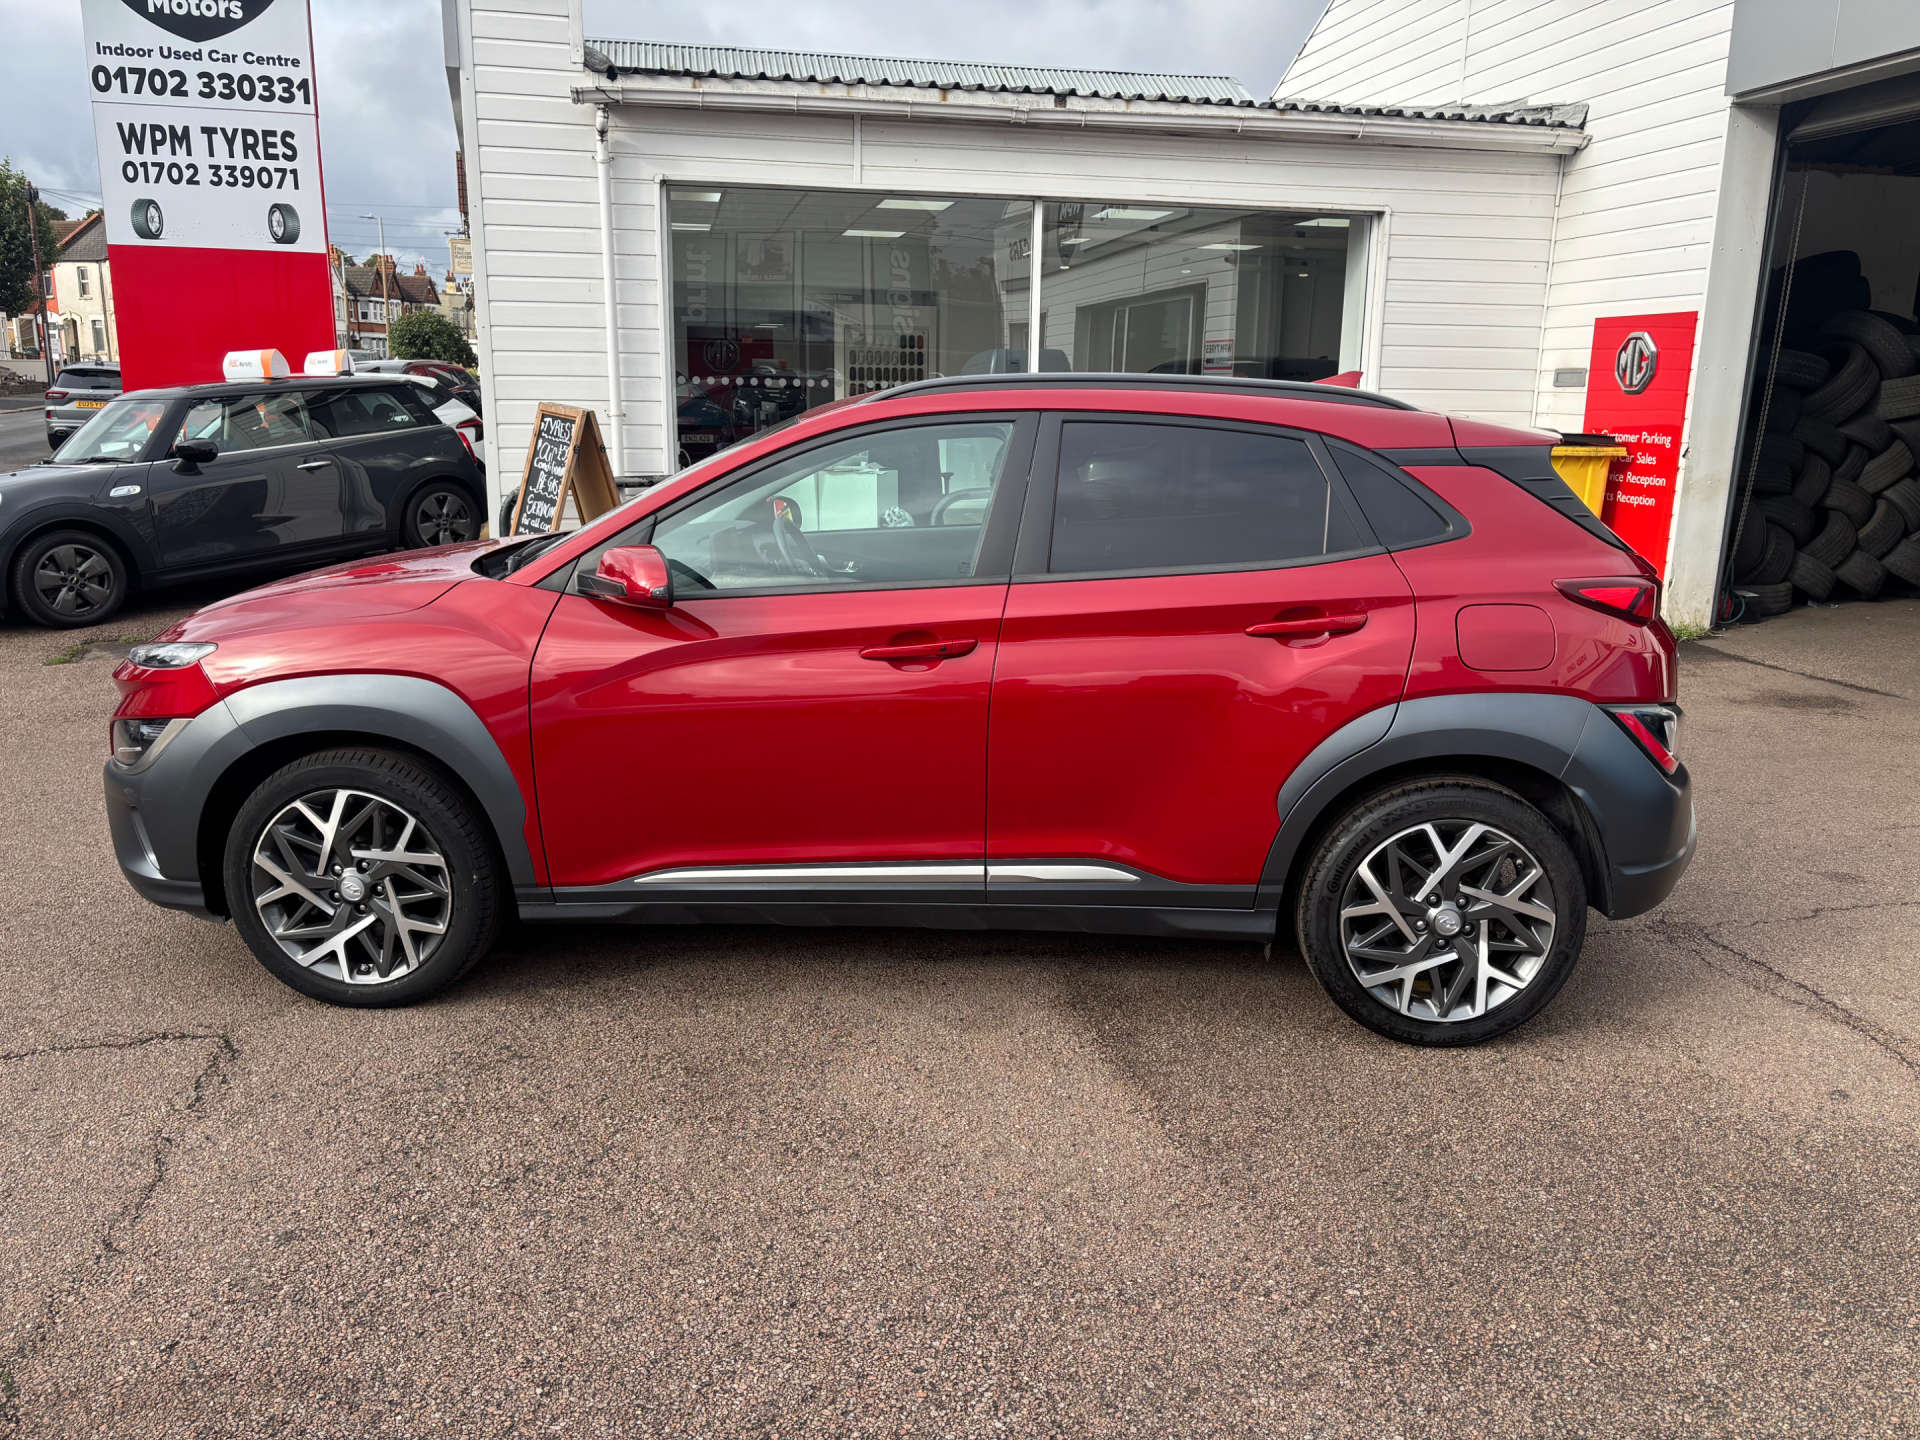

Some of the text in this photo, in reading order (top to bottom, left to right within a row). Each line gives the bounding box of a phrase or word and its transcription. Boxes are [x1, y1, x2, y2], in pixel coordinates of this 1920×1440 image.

[148, 0, 244, 20] Motors
[96, 41, 301, 67] Indoor Used Car Centre
[92, 65, 311, 105] 01702 330331
[116, 122, 298, 162] WPM TYRES
[122, 161, 300, 190] 01702 339071
[1618, 336, 1652, 389] MG
[1641, 432, 1672, 449] Parking
[1636, 452, 1656, 465] Sales
[1626, 472, 1666, 487] Reception
[1616, 491, 1655, 507] Reception
